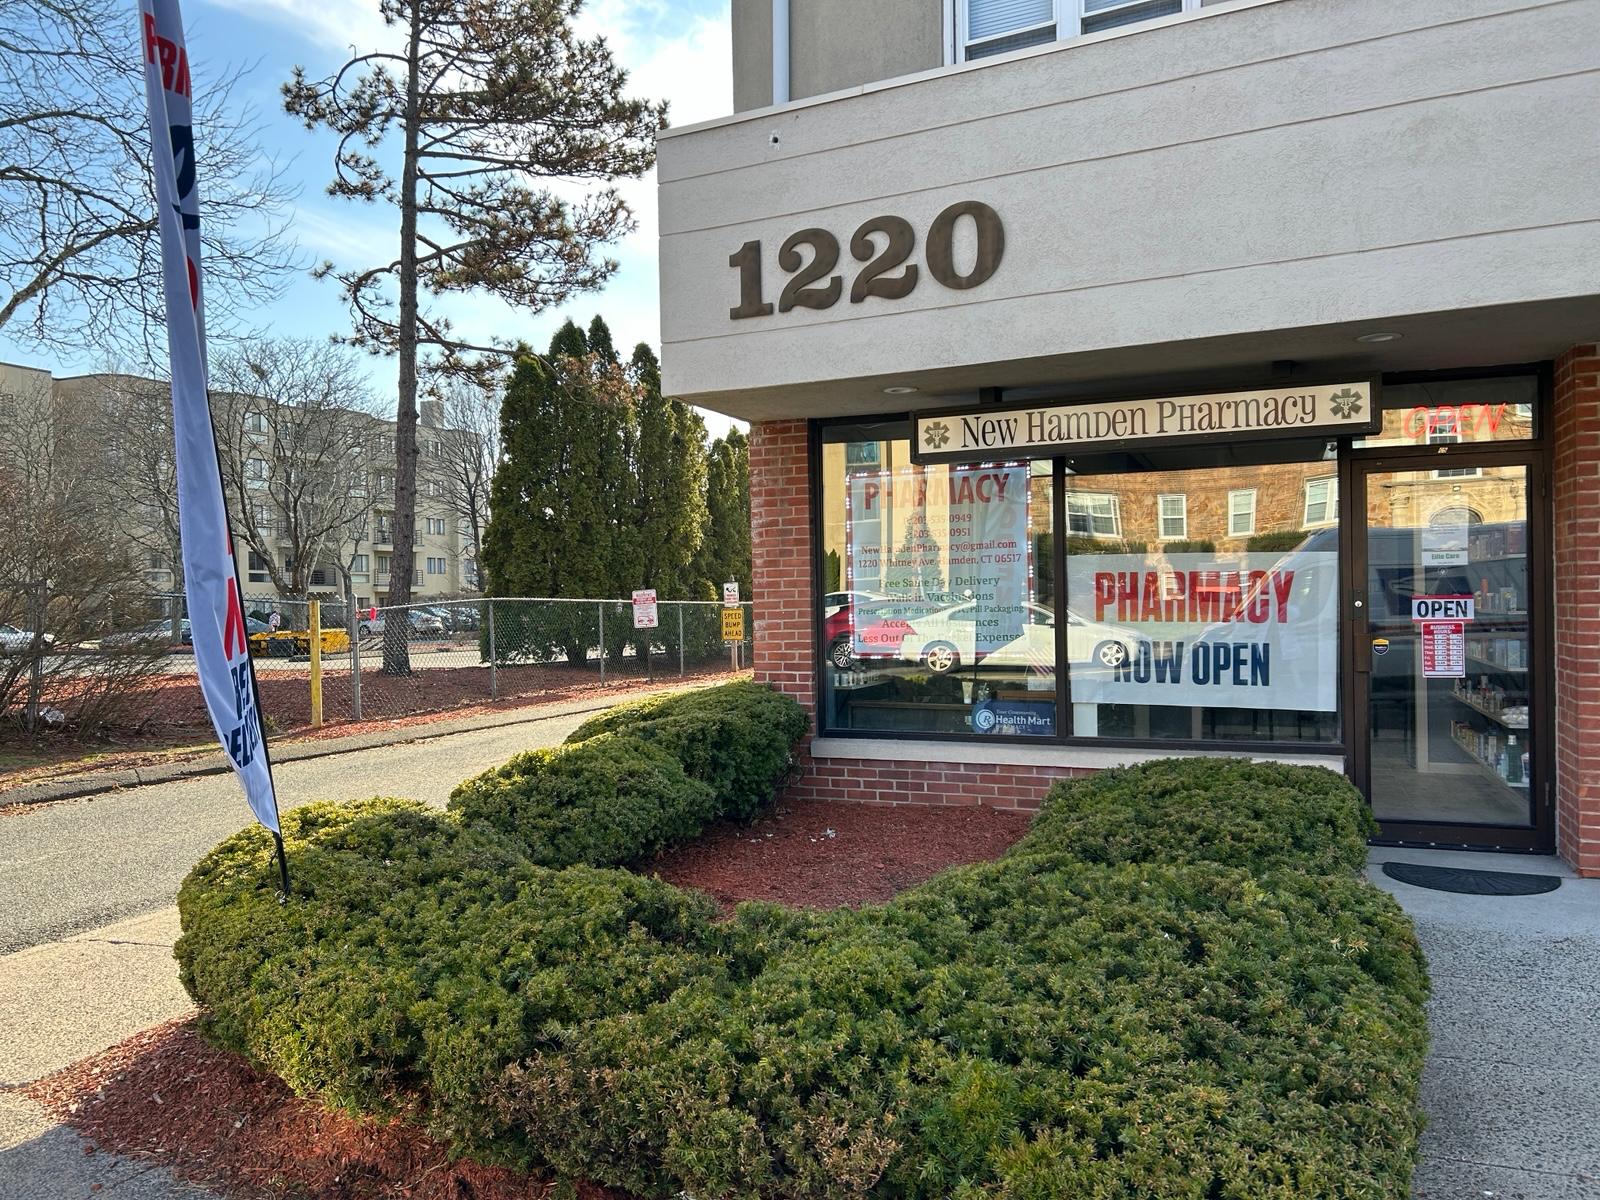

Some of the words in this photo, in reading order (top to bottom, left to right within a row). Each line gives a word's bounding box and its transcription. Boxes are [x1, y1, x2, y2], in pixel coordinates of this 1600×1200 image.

[729, 200, 1005, 320] 1220
[960, 416, 1018, 448] New
[1404, 402, 1506, 439] OPEN
[864, 473, 1011, 510] PHARMACY
[859, 559, 878, 569] 1220
[980, 554, 993, 564] CT
[994, 553, 1021, 564] 06517
[955, 576, 1000, 588] Delivery
[984, 603, 1024, 615] Packaging
[1094, 570, 1295, 624] PHARMACY
[1417, 600, 1468, 618] OPEN
[858, 632, 878, 643] Less
[975, 630, 1025, 647] Expense
[1114, 641, 1184, 684] NOW
[1192, 642, 1270, 687] OPEN
[996, 715, 1027, 726] Health
[1028, 715, 1051, 726] Mart
